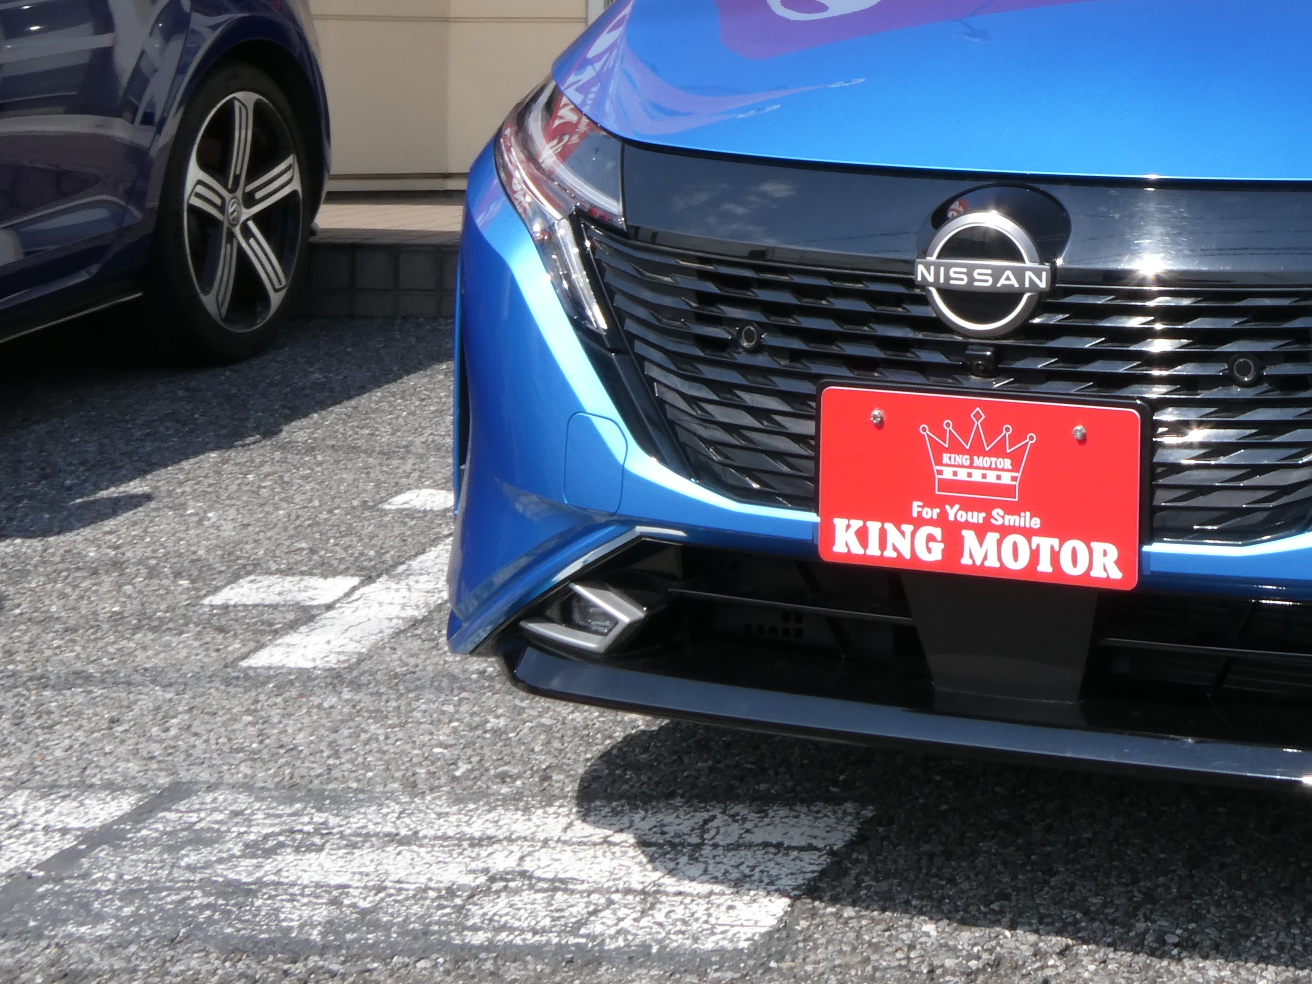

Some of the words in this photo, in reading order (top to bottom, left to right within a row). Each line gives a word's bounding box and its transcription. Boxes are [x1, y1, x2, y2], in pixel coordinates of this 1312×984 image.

[917, 263, 1047, 289] NISSAN
[942, 453, 971, 466] KING
[973, 455, 1012, 470] MOTOR
[912, 501, 940, 519] For
[945, 504, 986, 524] Your
[990, 508, 1042, 529] Smile
[832, 517, 945, 562] KING
[960, 529, 1123, 580] MOTOR
